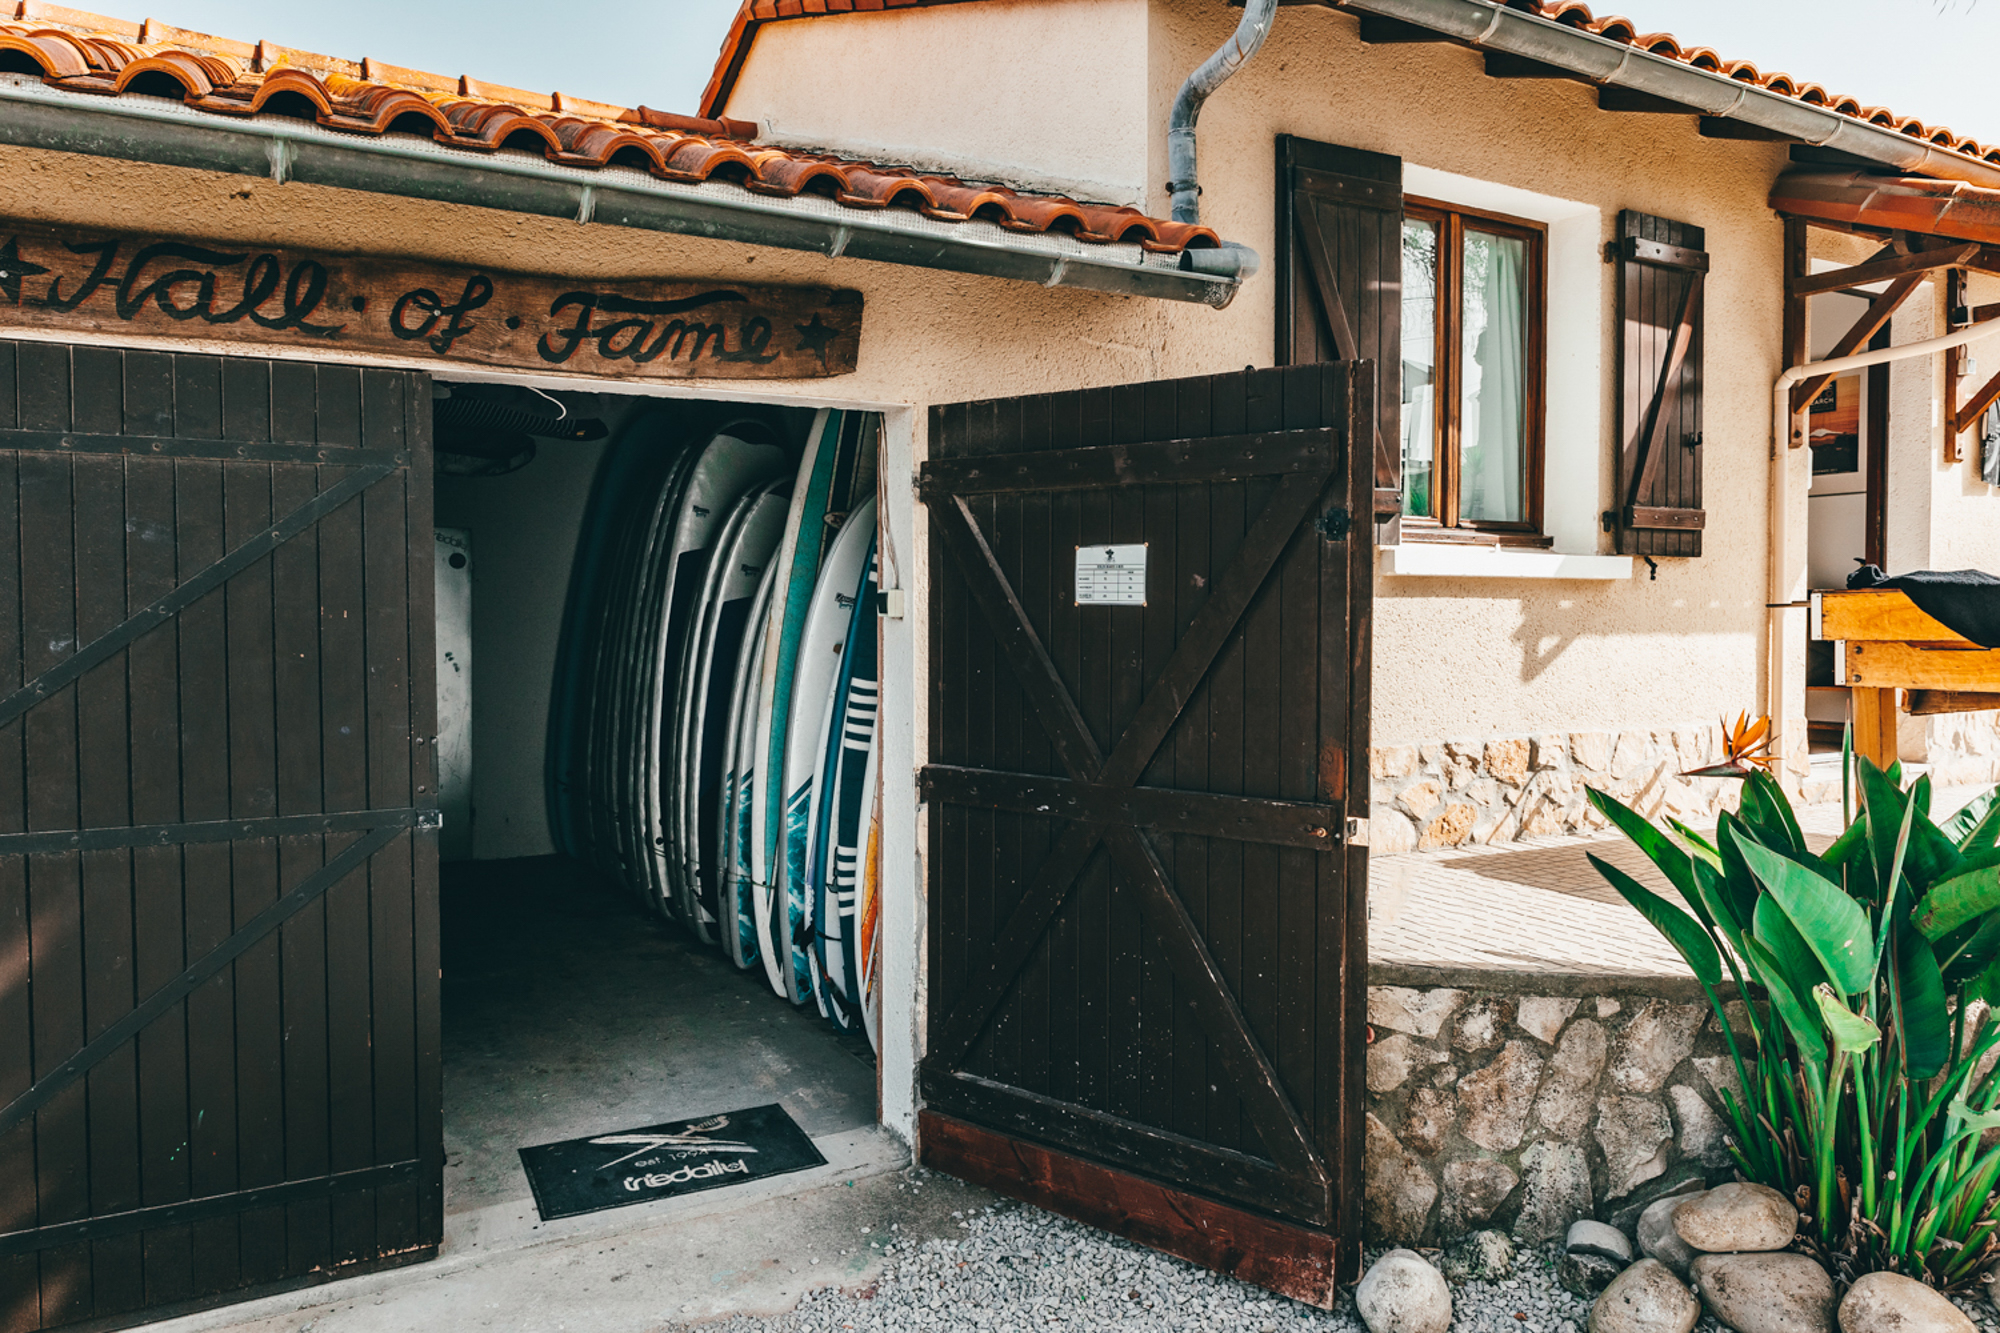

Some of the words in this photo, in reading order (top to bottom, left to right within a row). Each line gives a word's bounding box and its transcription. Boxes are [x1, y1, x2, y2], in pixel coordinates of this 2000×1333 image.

[47, 240, 348, 336] Hall
[537, 290, 781, 364] Fame
[623, 1158, 750, 1191] iriedaily
